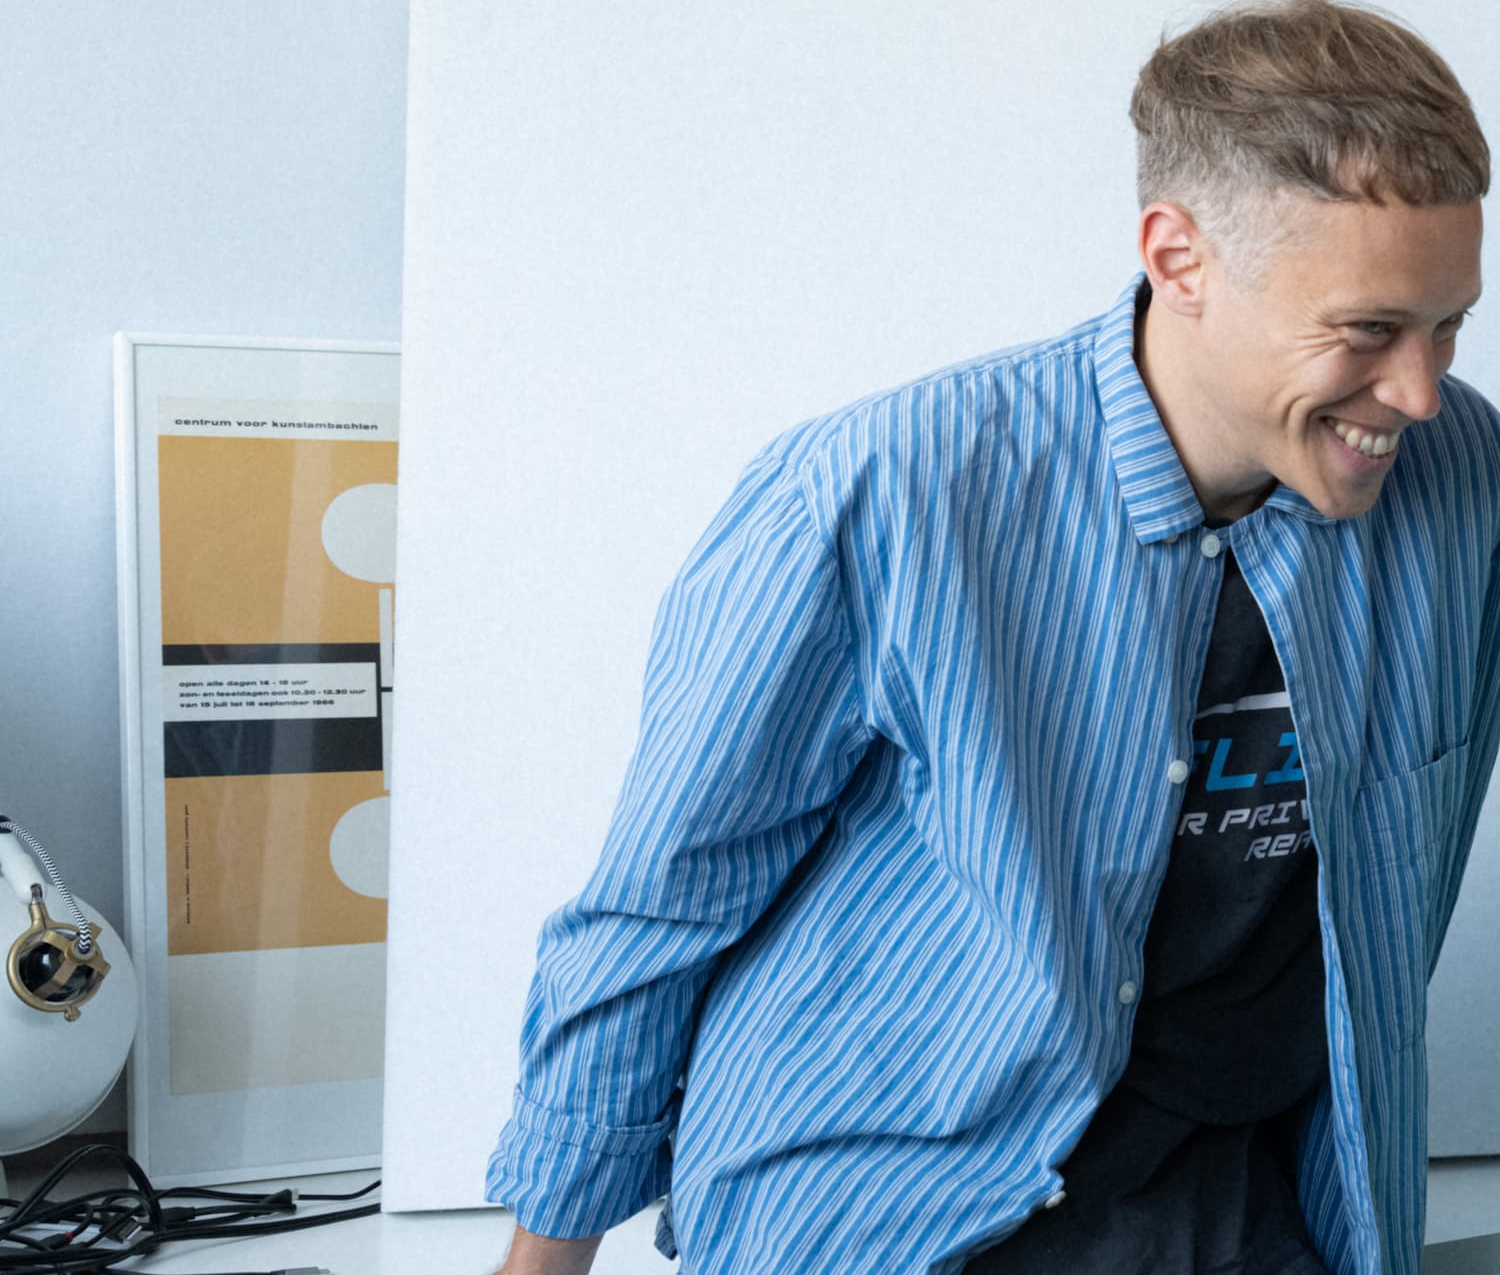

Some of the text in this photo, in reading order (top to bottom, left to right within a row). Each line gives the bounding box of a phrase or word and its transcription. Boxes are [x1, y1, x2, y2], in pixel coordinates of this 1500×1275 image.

[174, 417, 232, 427] centrum
[236, 420, 267, 428] voor
[257, 699, 310, 708] september
